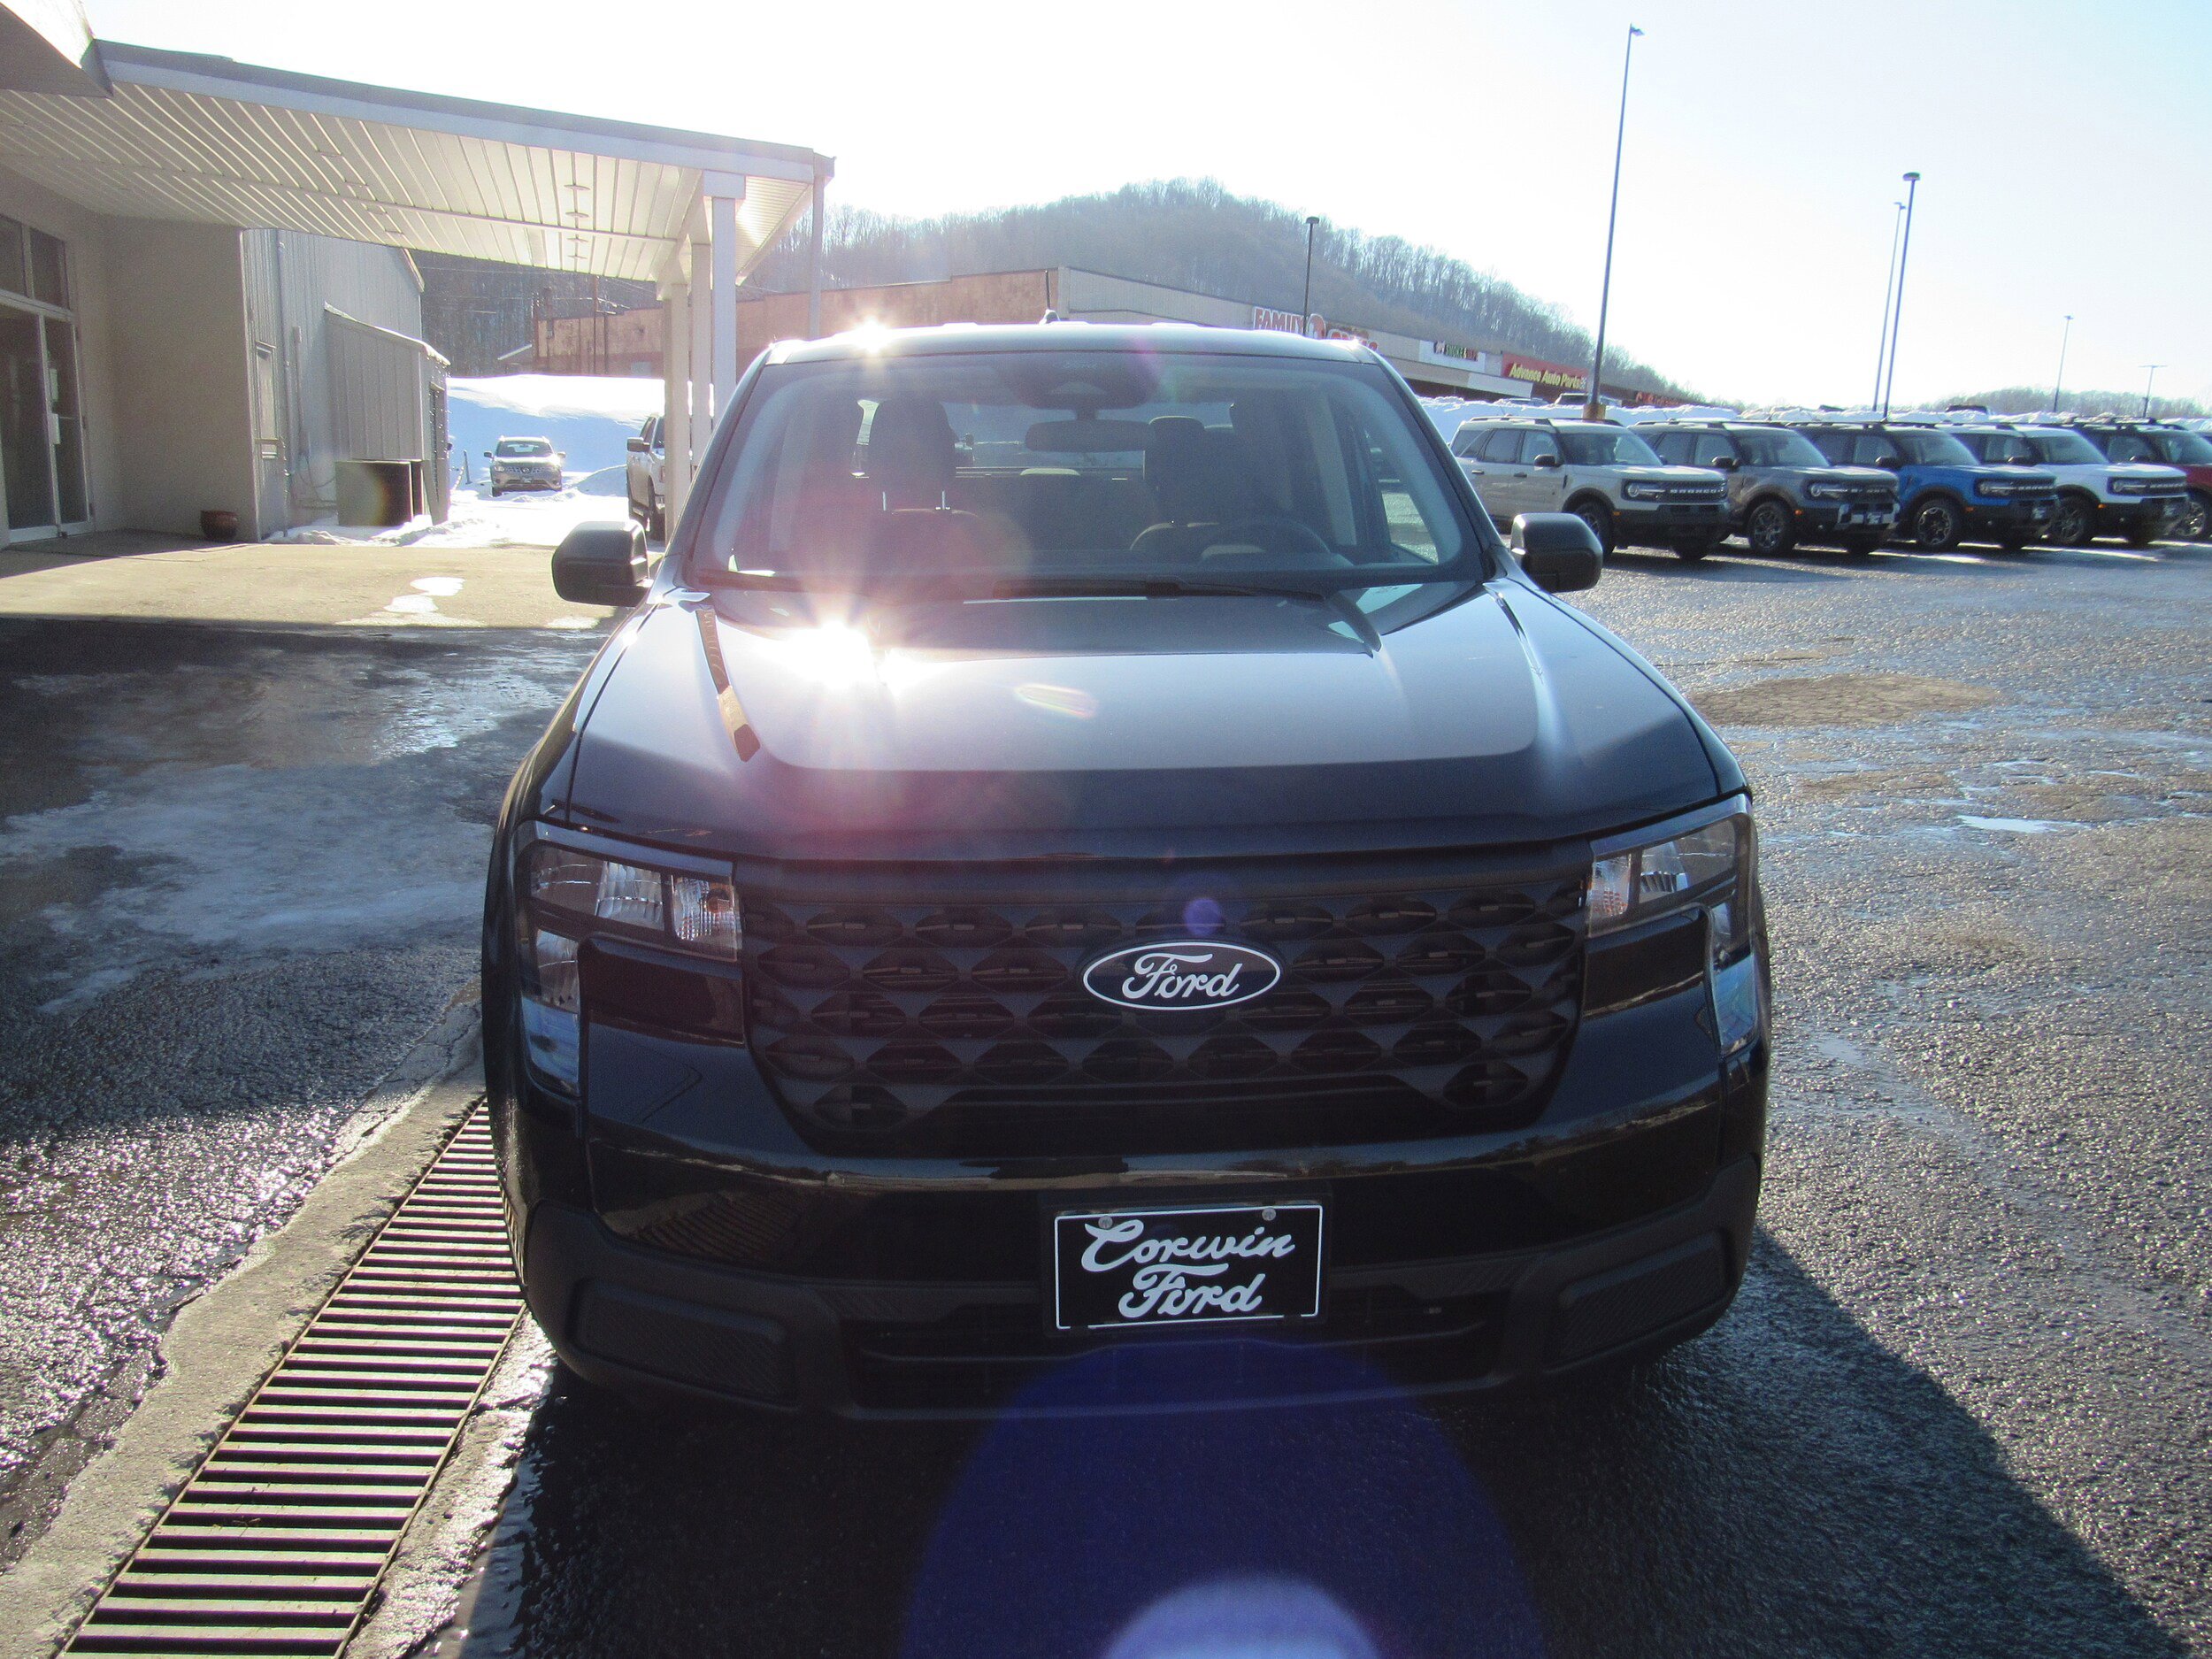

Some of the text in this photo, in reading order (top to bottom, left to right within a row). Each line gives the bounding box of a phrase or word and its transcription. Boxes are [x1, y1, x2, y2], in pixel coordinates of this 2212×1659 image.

[1509, 362, 1581, 389] Advance Auto Parts
[1122, 953, 1243, 999] Ford
[1081, 1219, 1295, 1272] Corwin
[1118, 1263, 1266, 1318] Ford
